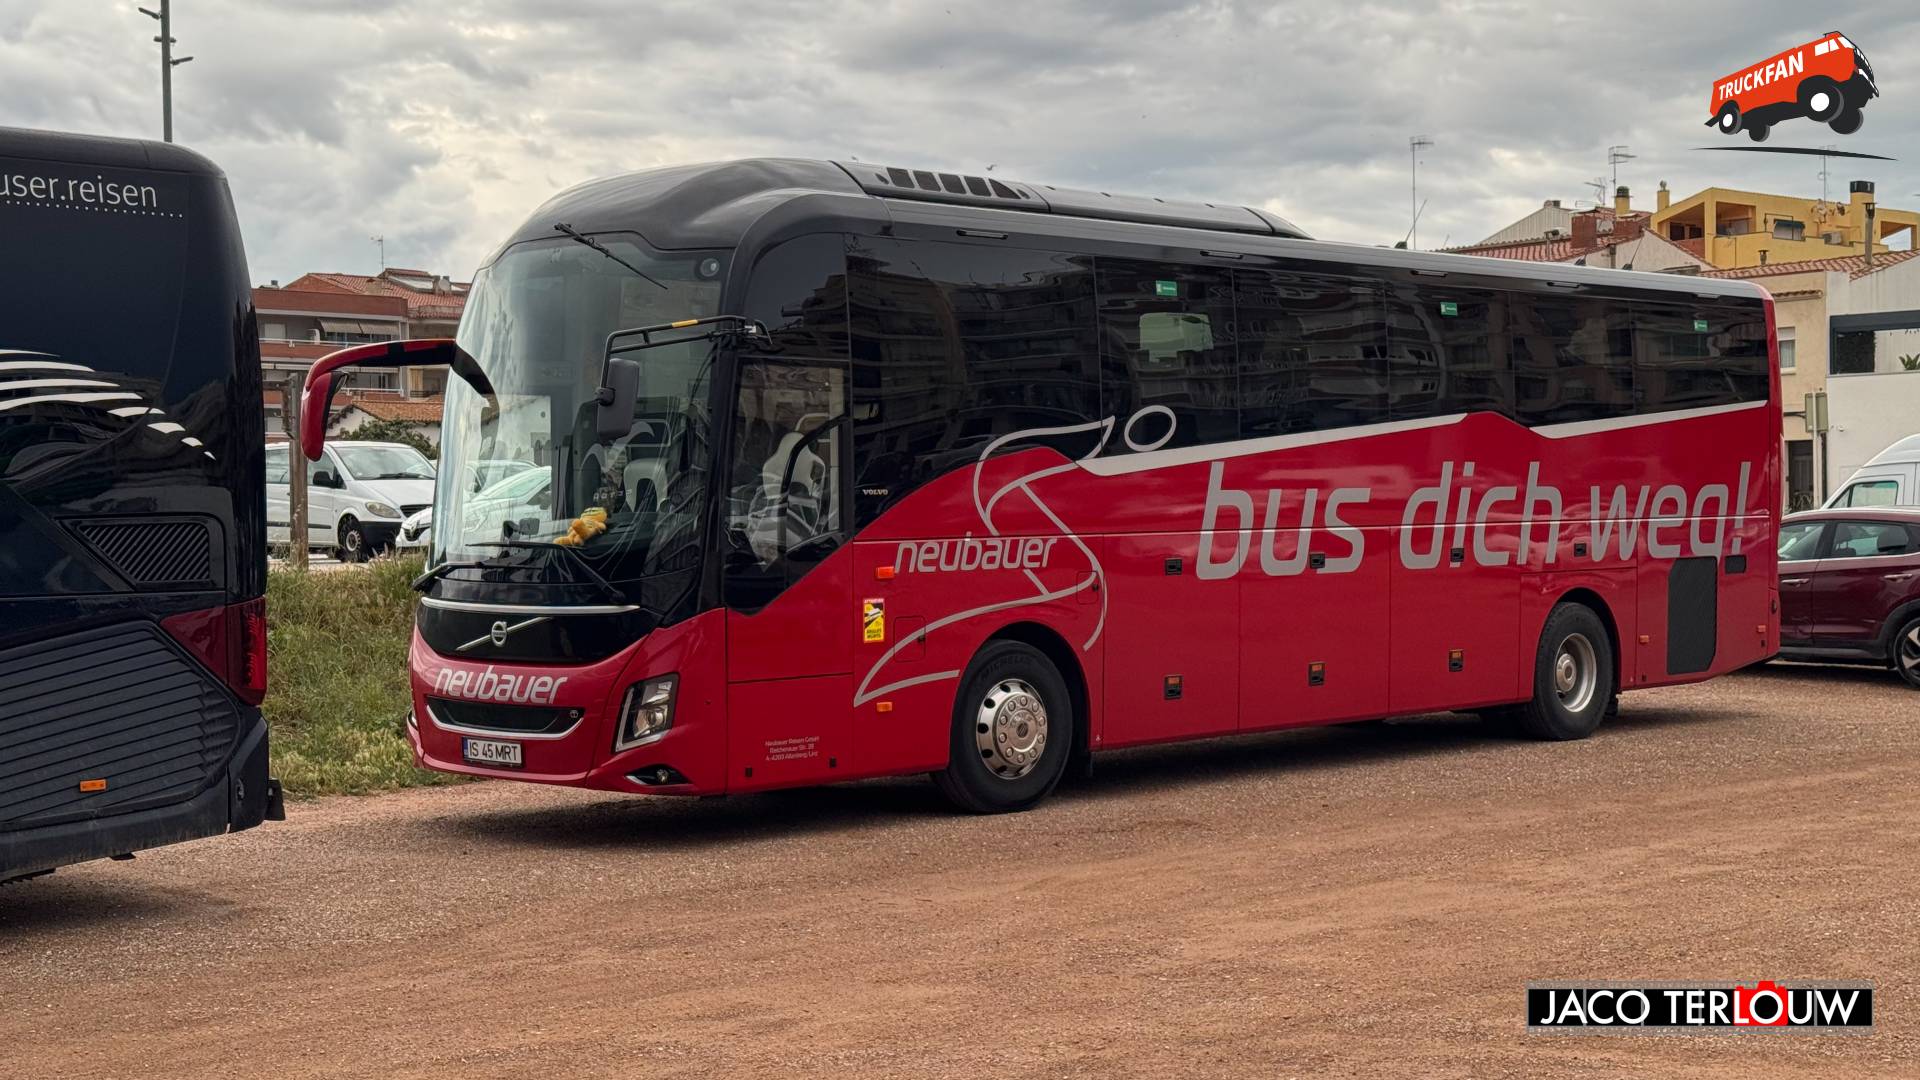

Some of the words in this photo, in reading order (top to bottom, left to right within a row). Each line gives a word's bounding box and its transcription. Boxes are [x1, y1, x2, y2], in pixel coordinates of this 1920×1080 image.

[862, 488, 889, 496] VOLVO
[1196, 461, 1371, 581] bus
[1399, 460, 1563, 570] dich
[1589, 460, 1752, 563] weg!
[895, 531, 1058, 574] neubauer
[434, 665, 568, 705] neubauer
[469, 741, 479, 757] IS
[482, 743, 494, 759] 45
[495, 744, 518, 761] MRT
